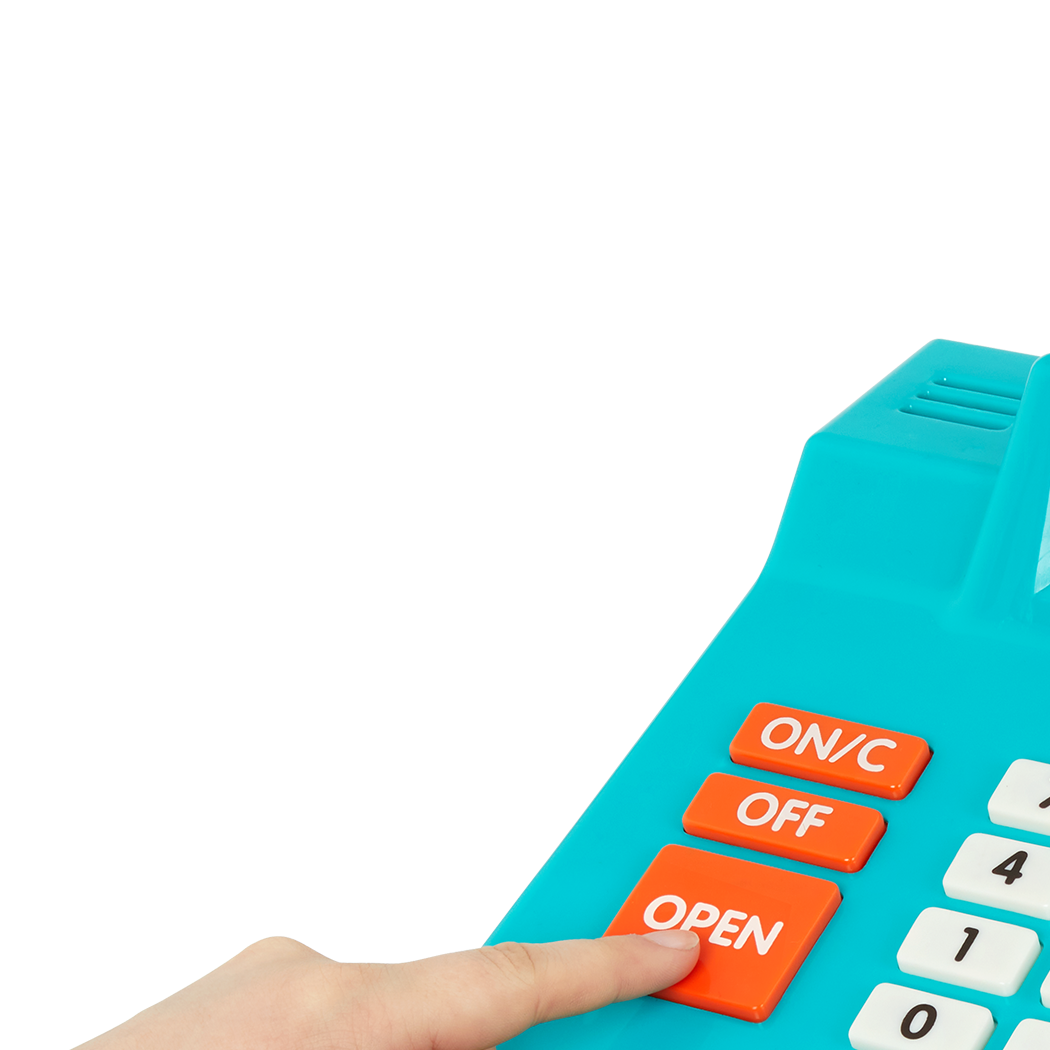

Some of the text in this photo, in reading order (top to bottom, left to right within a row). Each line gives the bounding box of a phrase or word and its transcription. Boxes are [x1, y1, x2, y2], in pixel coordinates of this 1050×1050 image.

[760, 716, 897, 773] ON/C
[736, 791, 834, 838] OFF
[990, 850, 1029, 886] 4
[642, 894, 785, 956] OPEN
[953, 925, 981, 962] 1
[899, 1003, 938, 1040] 0
